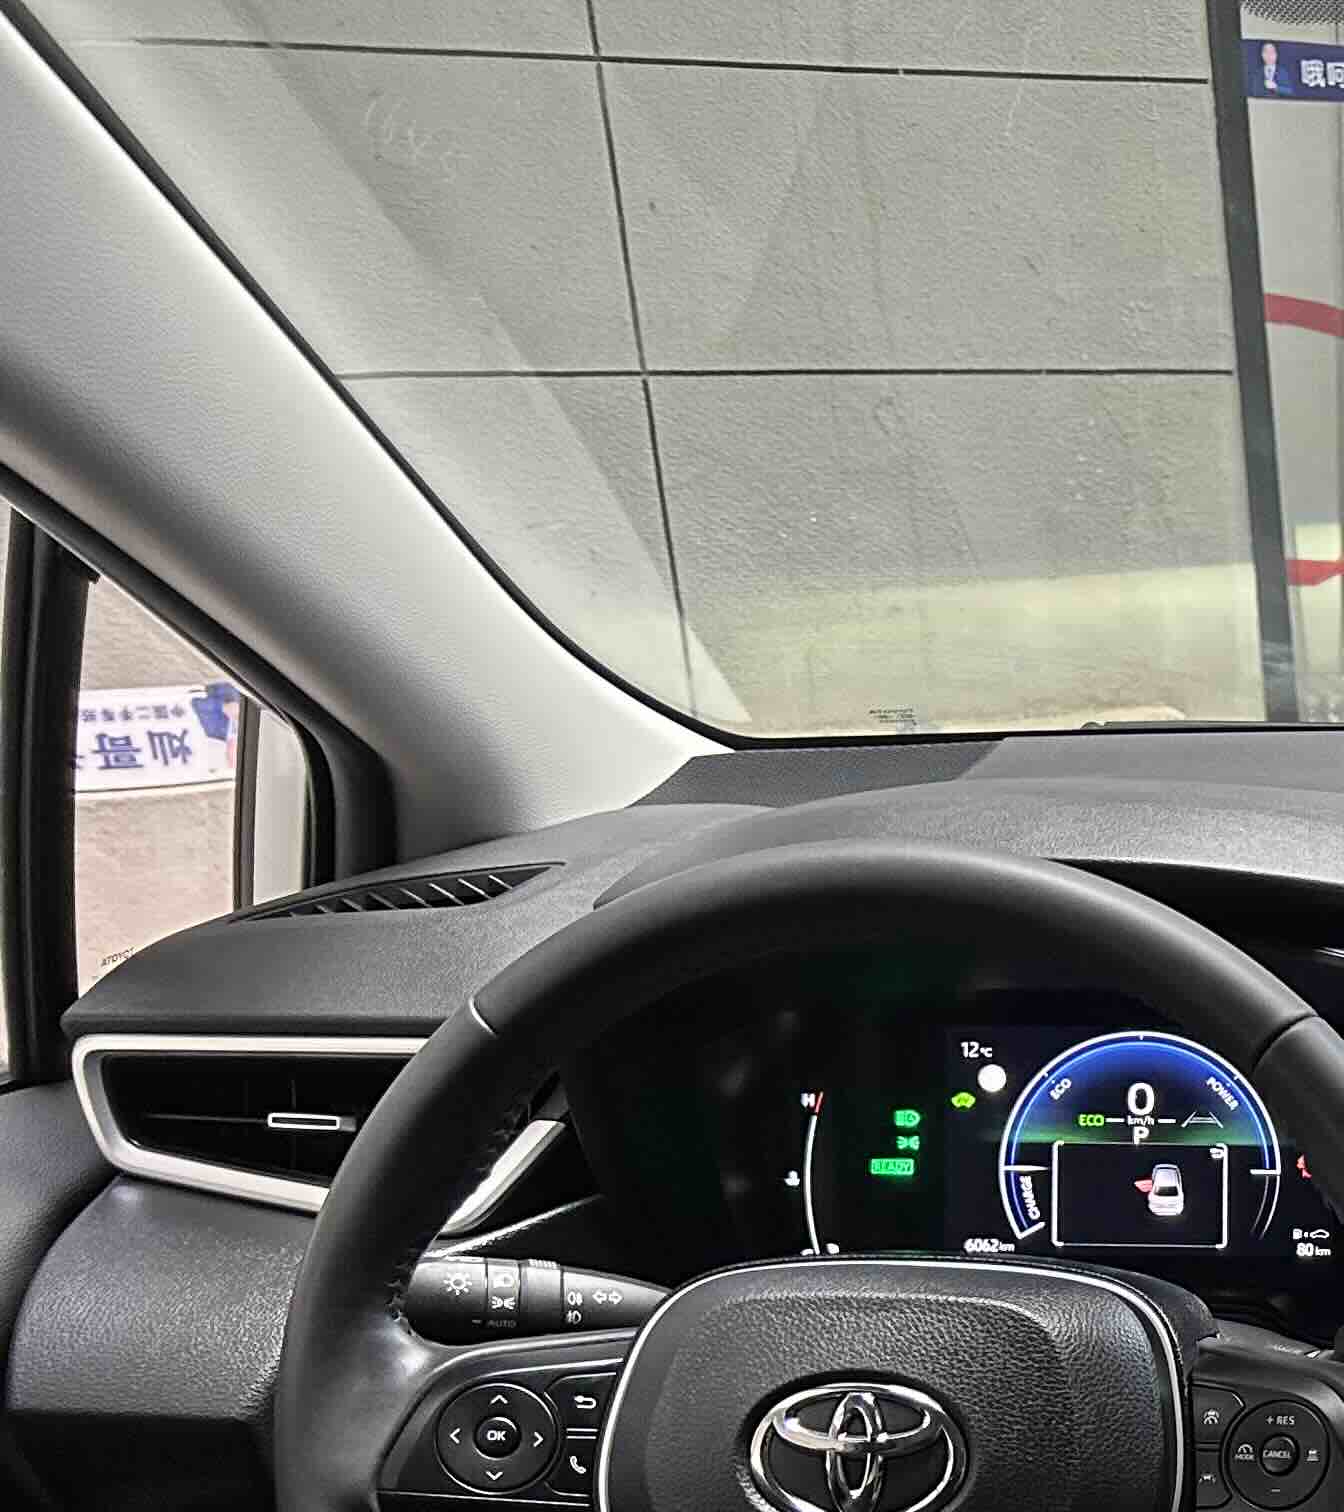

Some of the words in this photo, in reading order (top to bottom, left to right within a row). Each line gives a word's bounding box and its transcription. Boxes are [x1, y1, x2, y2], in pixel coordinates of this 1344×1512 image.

[76, 728, 192, 770] 灿哥
[1050, 1077, 1072, 1100] ECO
[1205, 1076, 1239, 1111] POWER
[1127, 1082, 1155, 1116] 0
[1078, 1114, 1105, 1127] ECO
[1127, 1115, 1155, 1127] km/h
[1133, 1127, 1150, 1145] P
[1019, 1175, 1041, 1220] CHARGE
[487, 1319, 517, 1329] AUTO
[1276, 1415, 1295, 1425] RES
[486, 1430, 507, 1441] OK
[1262, 1449, 1291, 1459] CANCEL
